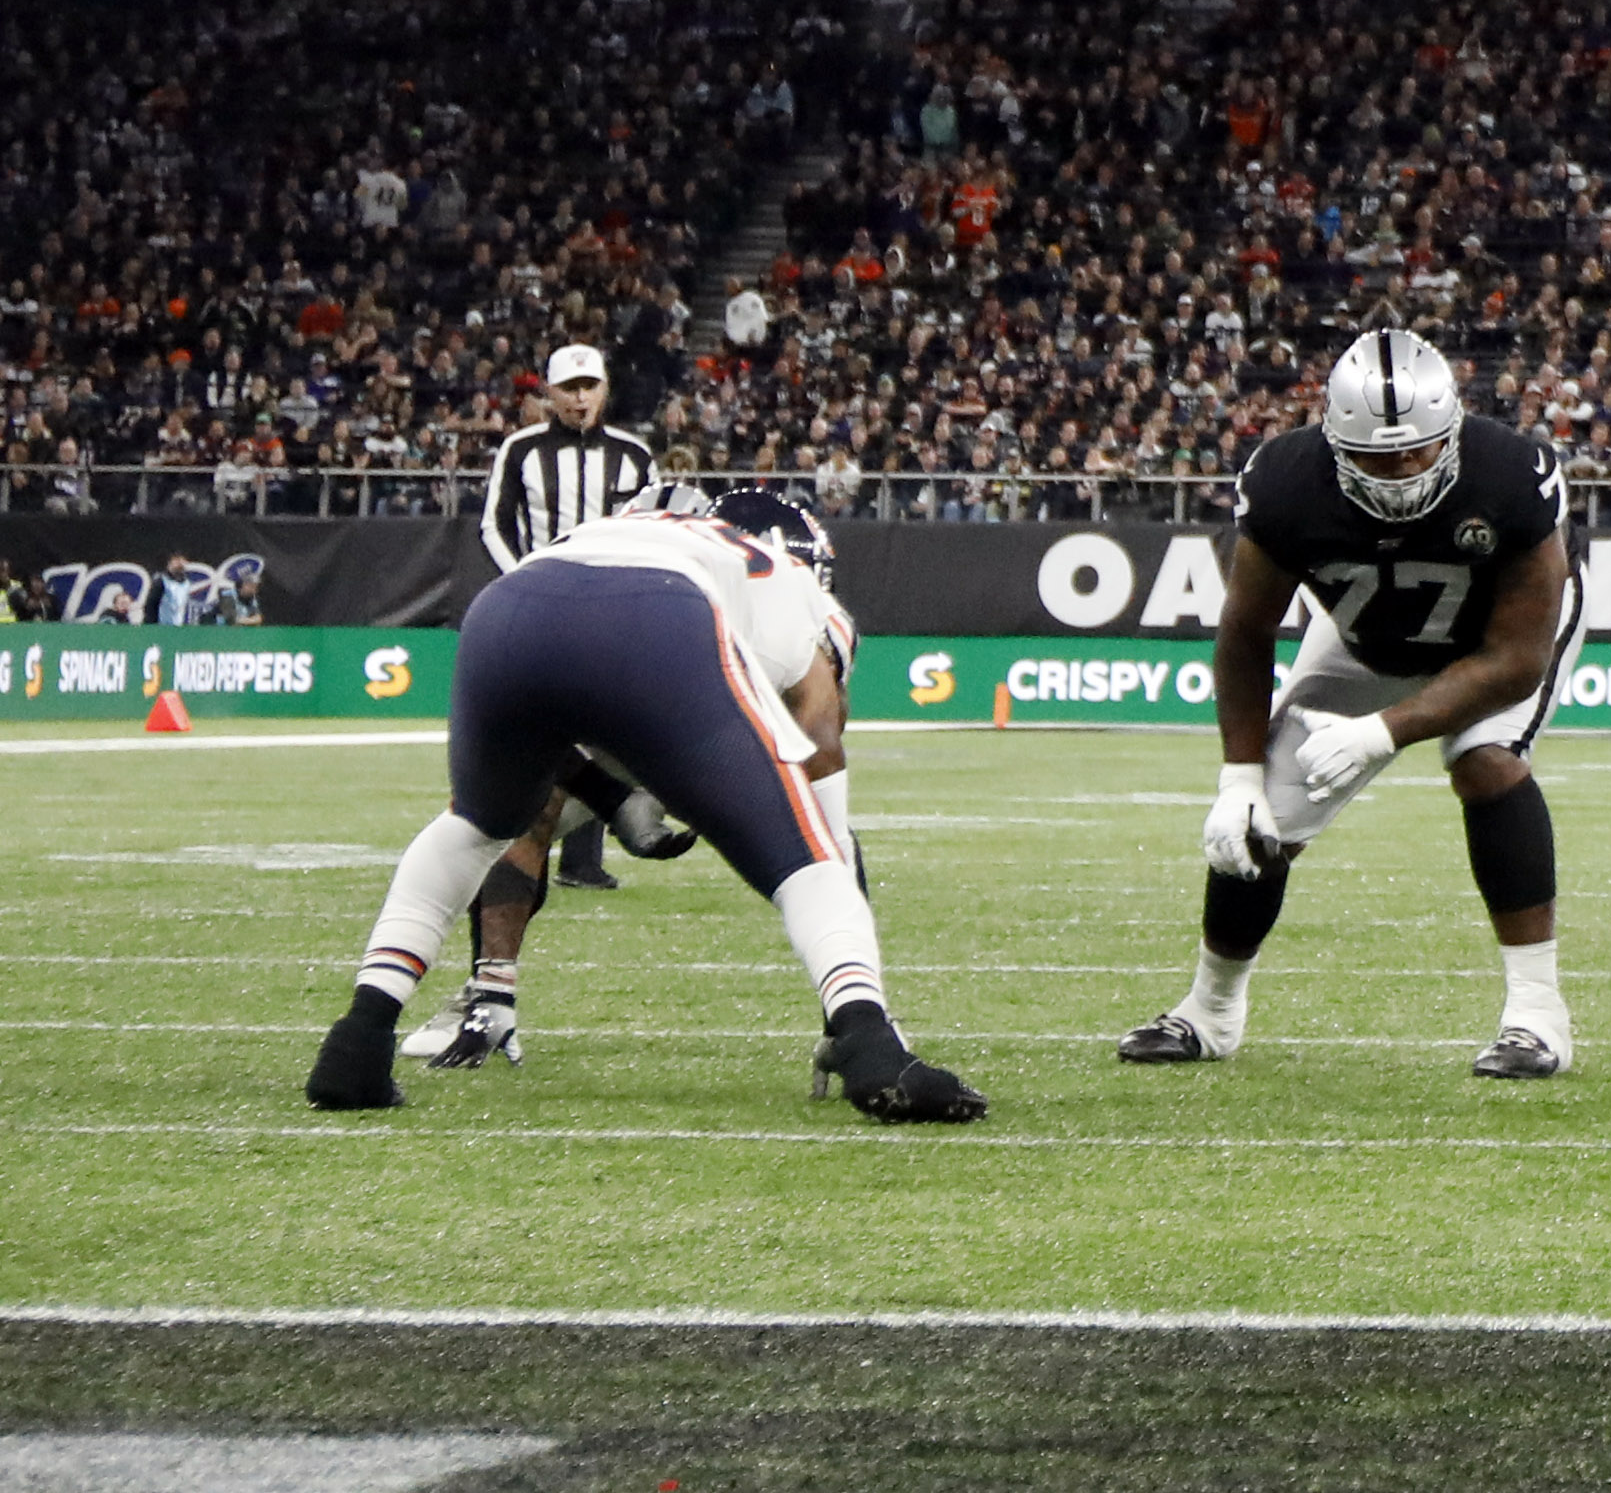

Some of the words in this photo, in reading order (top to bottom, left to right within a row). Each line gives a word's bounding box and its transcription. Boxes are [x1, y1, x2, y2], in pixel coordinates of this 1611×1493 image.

[1310, 561, 1472, 644] 77
[58, 650, 126, 693] SPINACH
[1007, 659, 1169, 703] CRISPY
